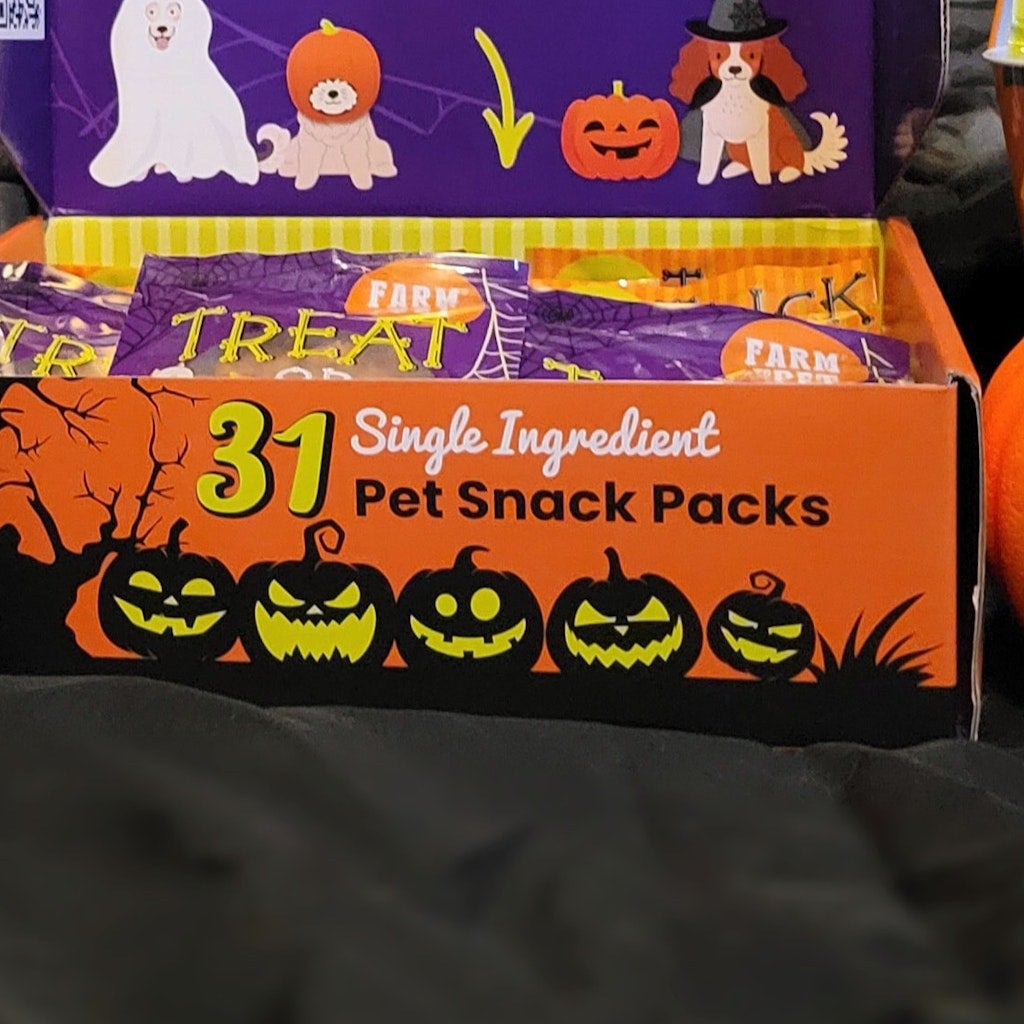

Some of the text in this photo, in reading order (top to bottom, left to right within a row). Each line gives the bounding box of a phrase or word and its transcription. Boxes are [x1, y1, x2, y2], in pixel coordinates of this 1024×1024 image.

[367, 279, 460, 312] FARM
[171, 305, 468, 371] TREAT
[744, 337, 841, 375] FARM
[196, 400, 335, 518] 31
[350, 405, 721, 478] Single Ingredient
[355, 479, 831, 528] Pet Snack Packs
